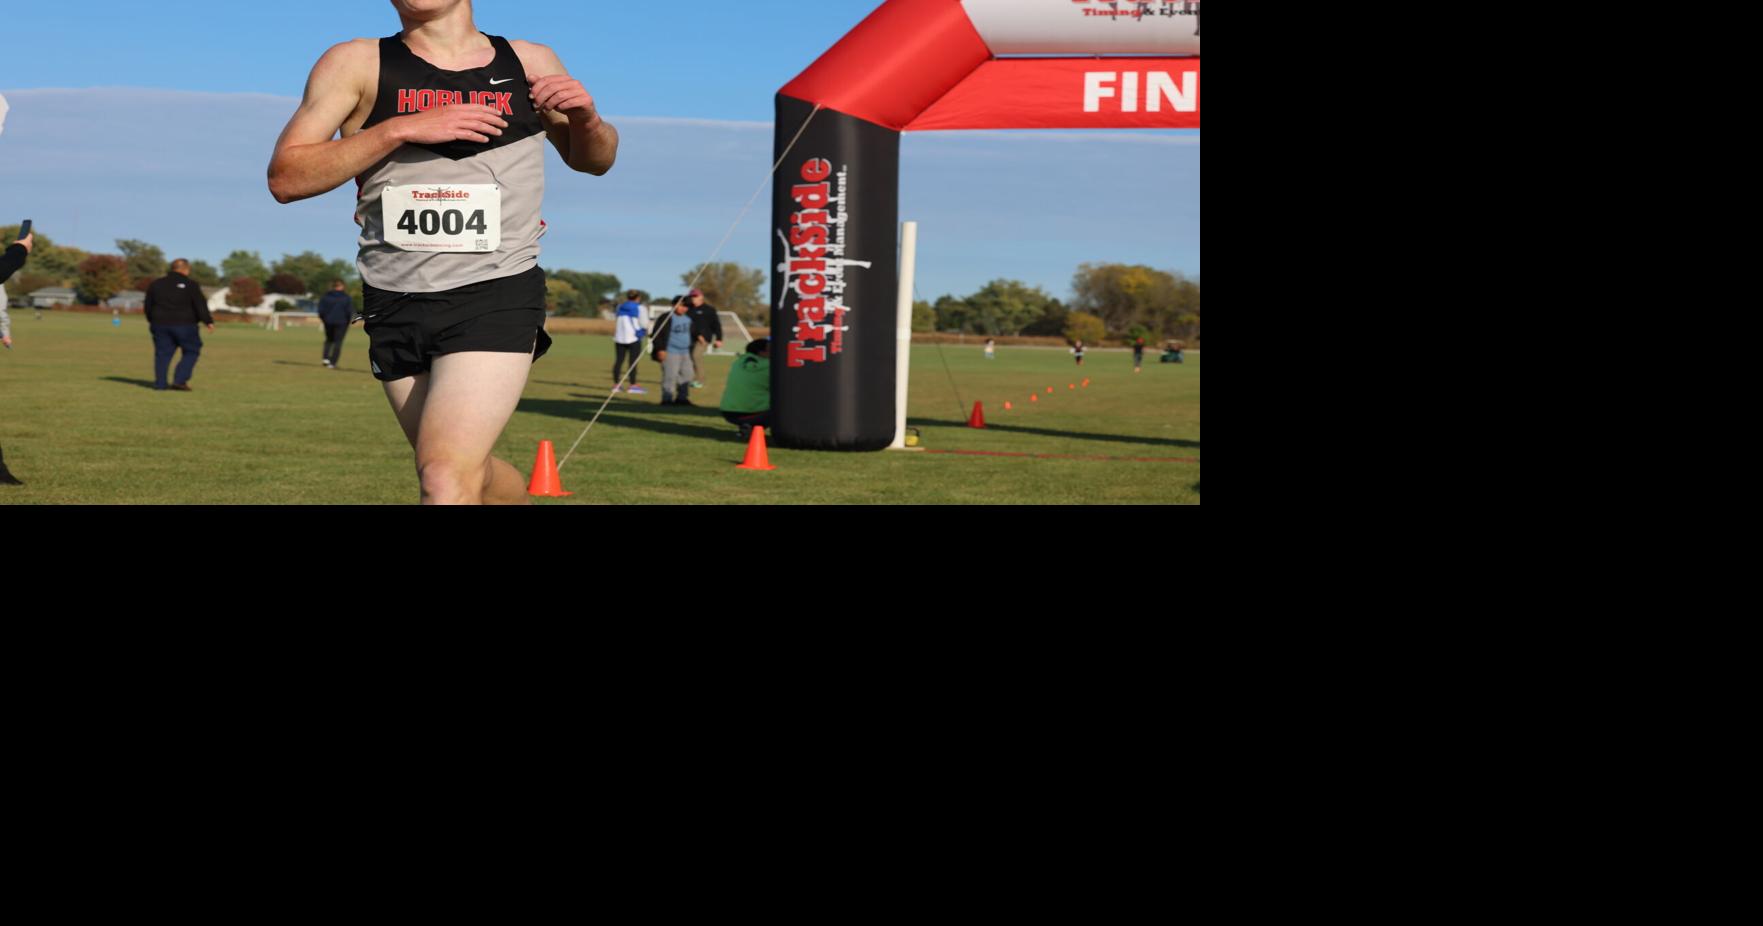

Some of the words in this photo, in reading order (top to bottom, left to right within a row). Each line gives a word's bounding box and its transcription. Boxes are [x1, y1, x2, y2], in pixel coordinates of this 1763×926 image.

[1083, 71, 1197, 112] FIN
[397, 209, 487, 235] 4004
[787, 158, 831, 367] TrackSide
